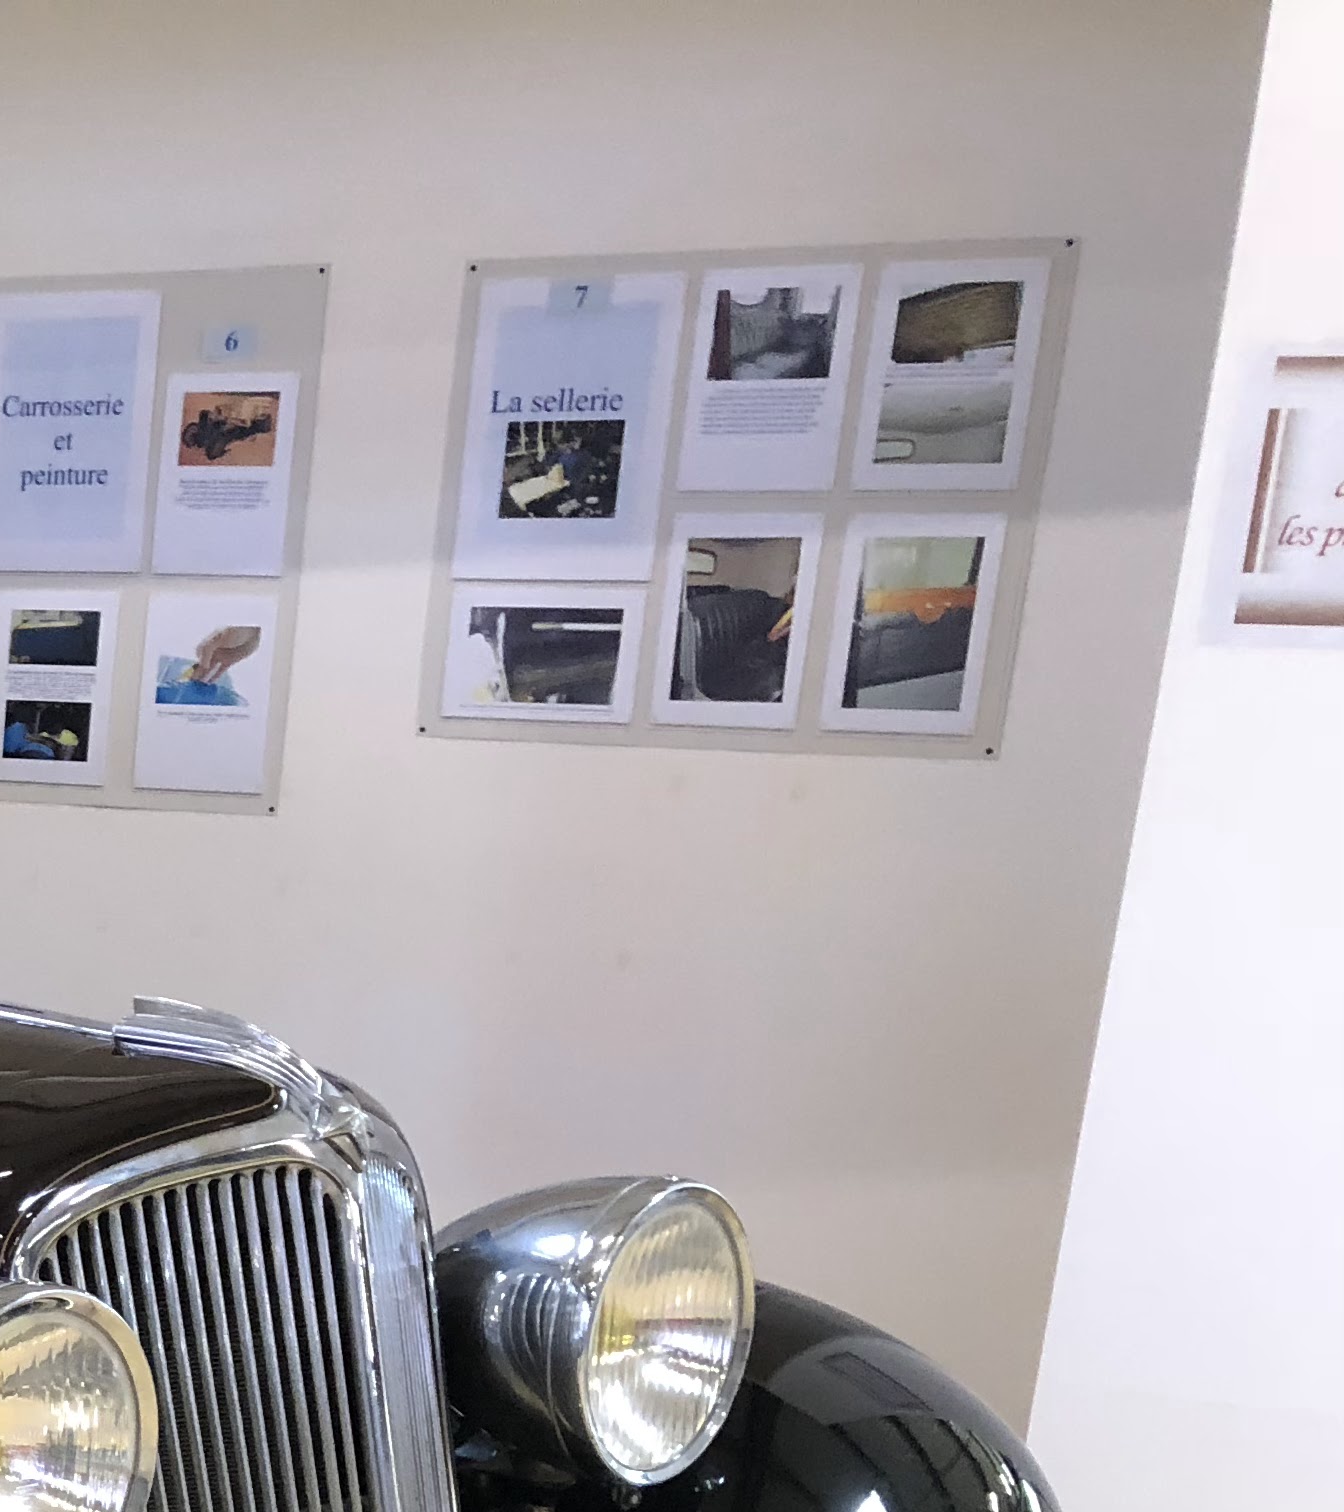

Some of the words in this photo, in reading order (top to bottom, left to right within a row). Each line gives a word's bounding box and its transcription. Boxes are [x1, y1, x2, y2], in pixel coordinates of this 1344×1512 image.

[575, 285, 589, 309] 7
[224, 330, 239, 352] 6
[2, 394, 125, 418] Carrosserie
[491, 390, 522, 414] La
[530, 386, 624, 413] sellerie
[53, 431, 73, 451] et
[19, 463, 109, 492] peinture
[1277, 514, 1316, 546] les
